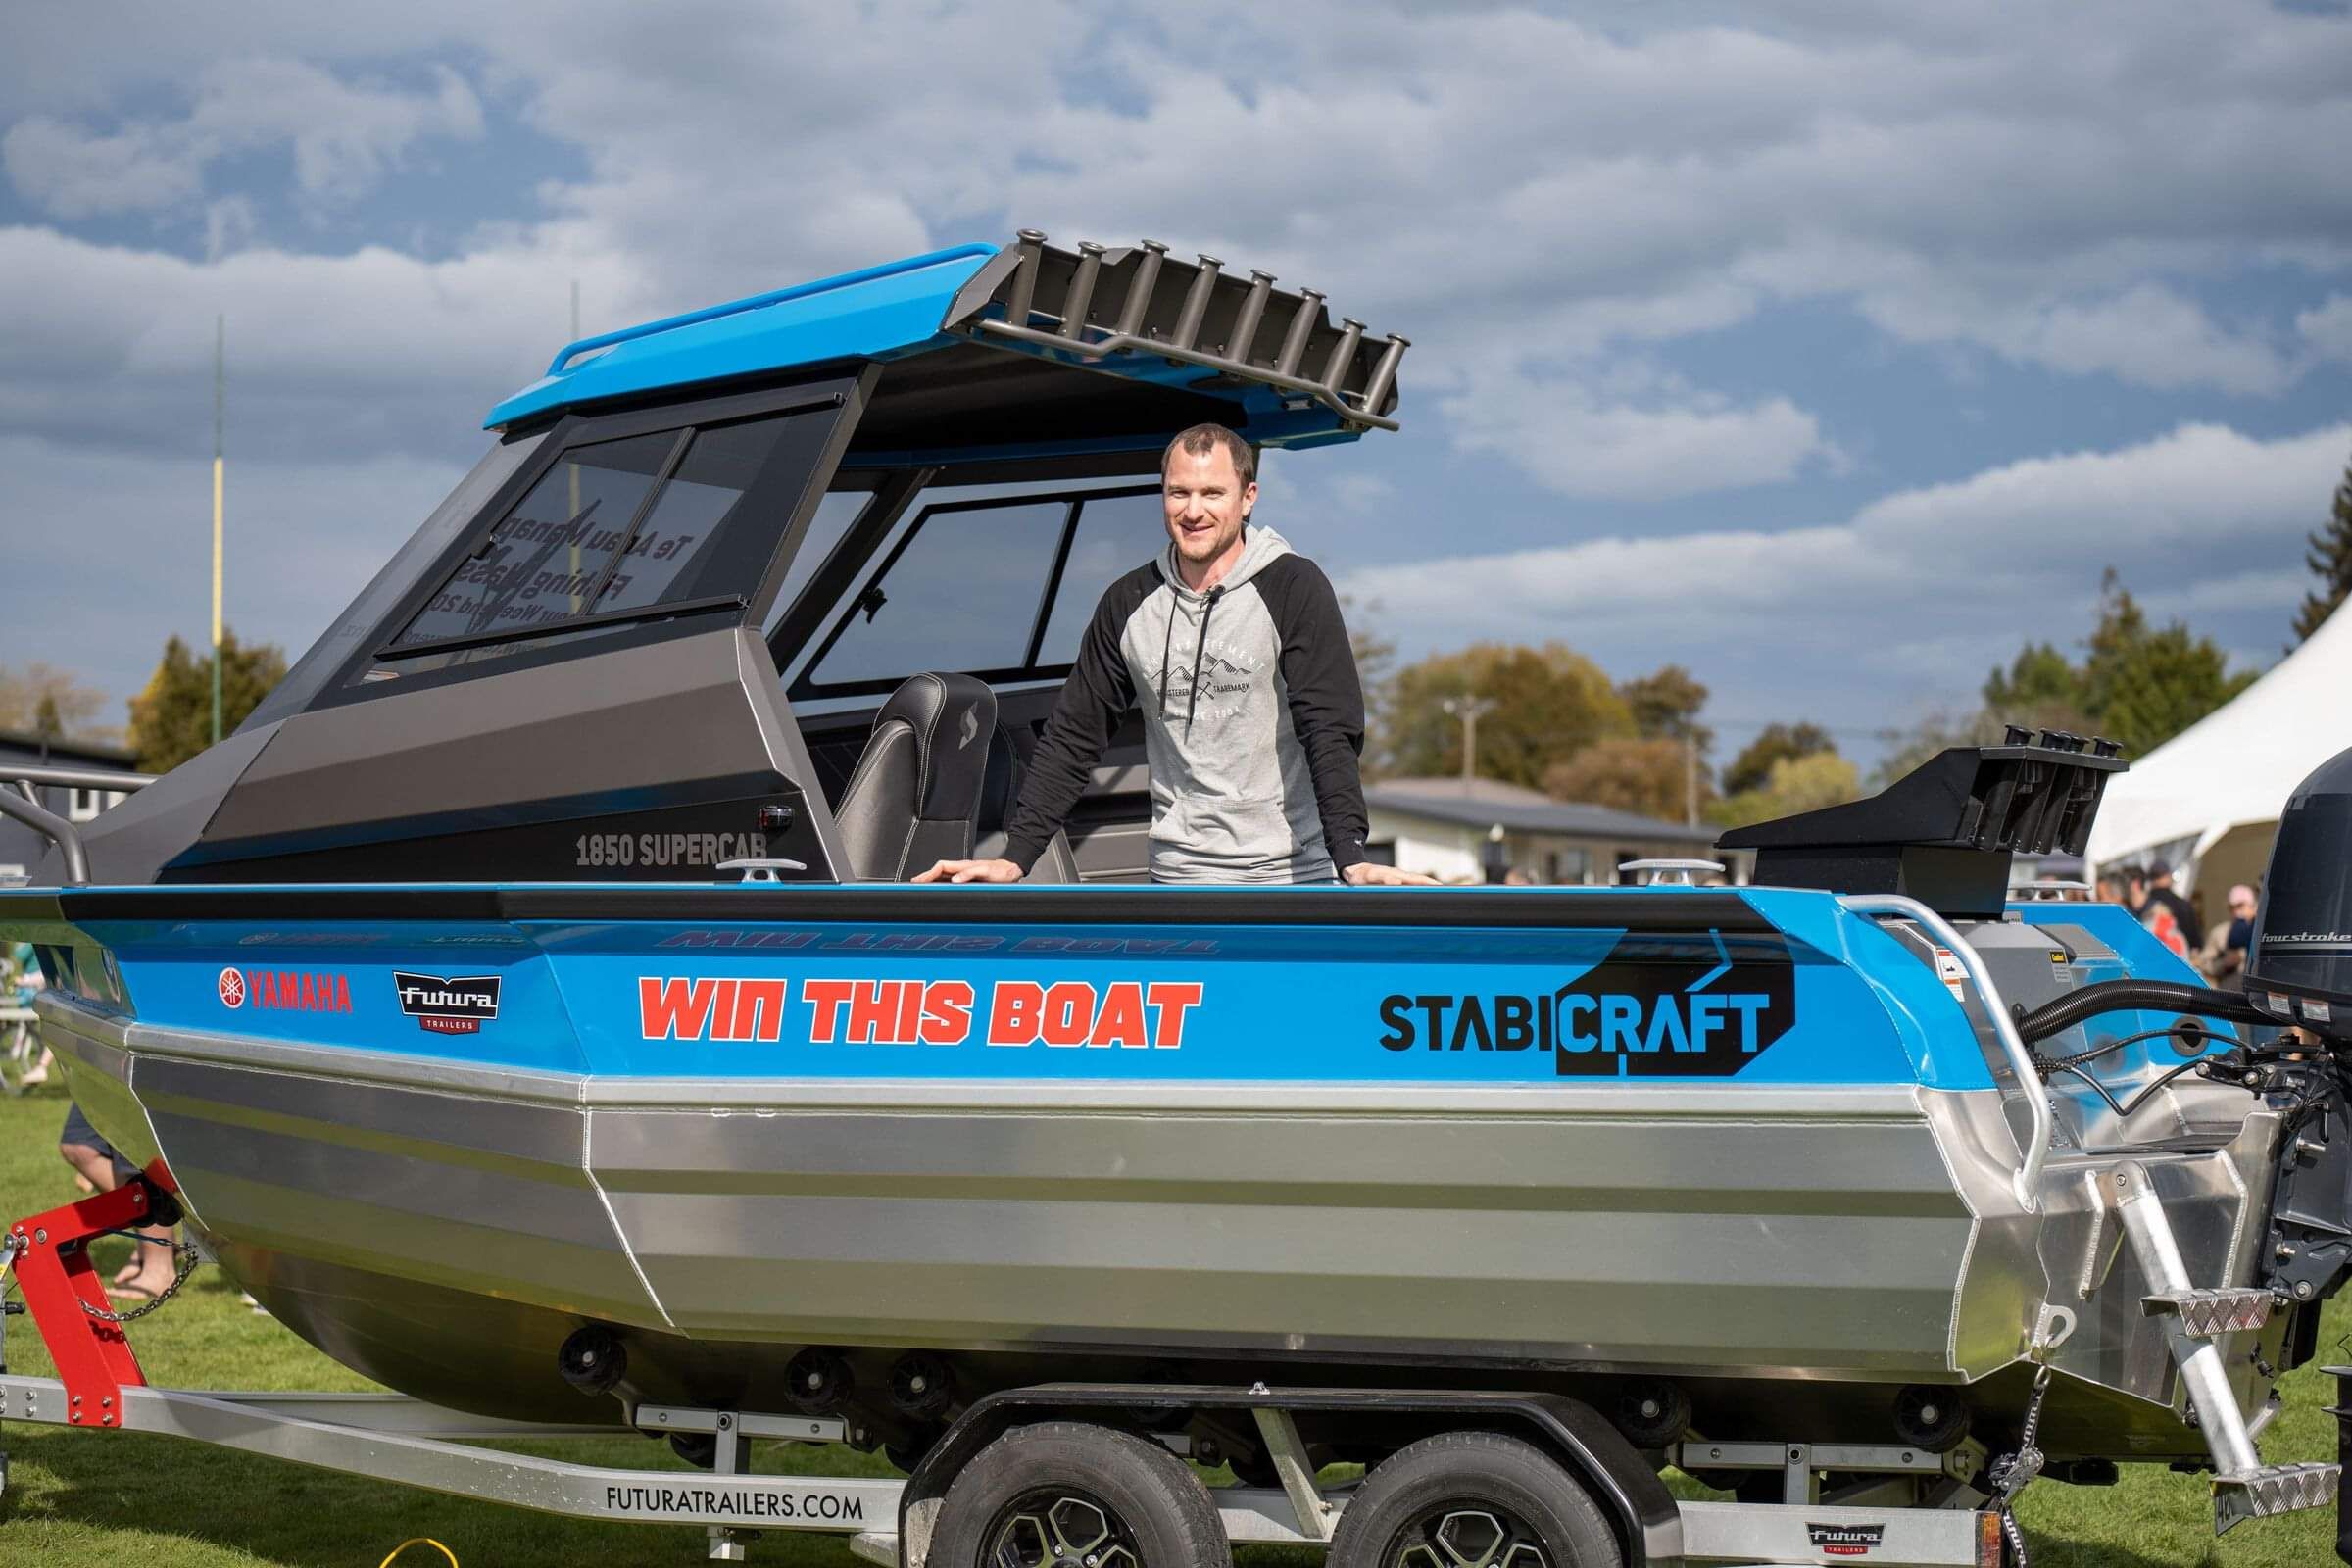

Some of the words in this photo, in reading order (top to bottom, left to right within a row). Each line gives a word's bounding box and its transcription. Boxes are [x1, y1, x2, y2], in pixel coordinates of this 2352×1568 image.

[576, 834, 634, 866] 1850
[639, 833, 767, 866] SUPERCAB
[247, 971, 353, 1013] YAMAHA
[401, 986, 497, 1008] Futura
[426, 1019, 473, 1030] TRAILERS
[639, 977, 787, 1042] WIN
[802, 980, 975, 1046] THIS
[986, 981, 1204, 1049] BOAT
[1379, 994, 1770, 1053] STABICRAFT
[607, 1487, 863, 1520] FUTURATRAILERS.COM
[1810, 1530, 1882, 1542] Futura
